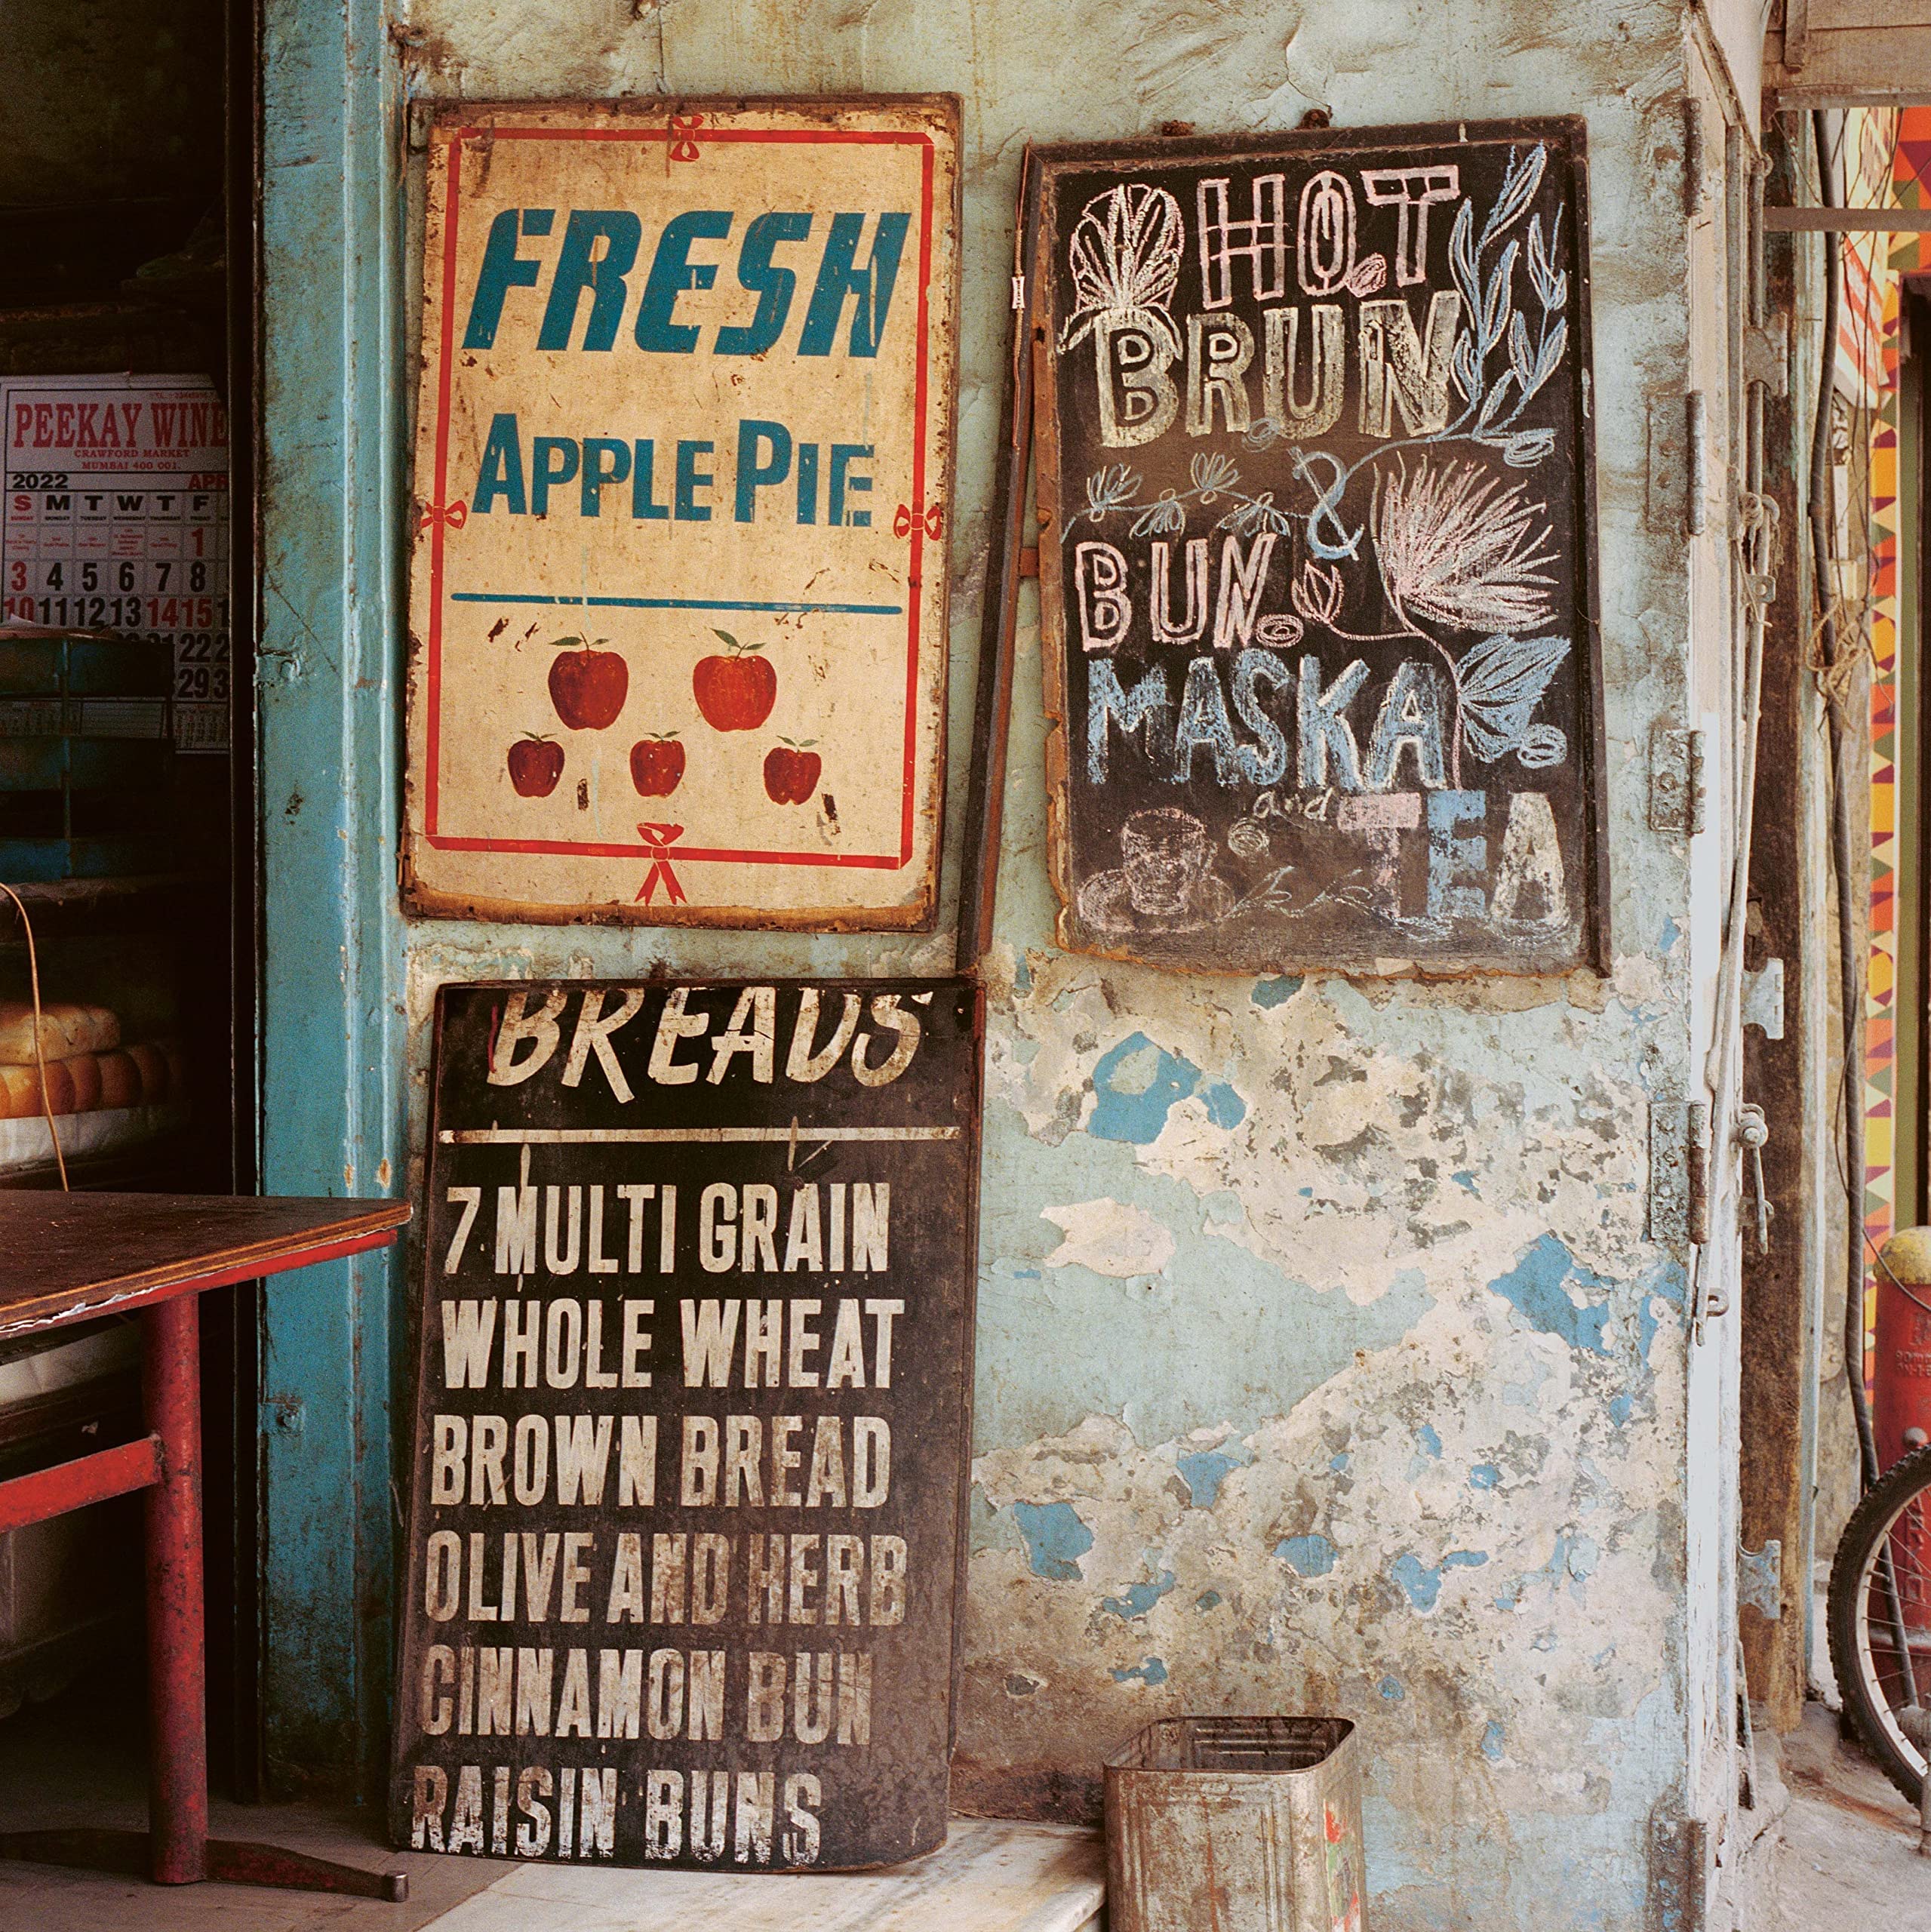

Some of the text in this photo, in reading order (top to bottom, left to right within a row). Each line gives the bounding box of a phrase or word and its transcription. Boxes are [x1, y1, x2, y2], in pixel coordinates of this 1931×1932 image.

[462, 208, 912, 358] FRESH
[1198, 165, 1461, 309] HOT
[1095, 289, 1462, 448] BRUN
[14, 403, 143, 448] PEEKAY
[74, 449, 190, 458] CRAWFORD MARKET
[82, 462, 129, 470] MUMBAI
[132, 462, 153, 470] 400
[471, 413, 875, 527] APPLE PIE
[12, 474, 68, 489] 2022
[14, 495, 210, 511] S M T W T F
[11, 561, 207, 592] 3 4 5 6 7 8
[191, 528, 204, 557] 1
[39, 597, 68, 626] 11
[75, 597, 106, 628] 12
[110, 597, 142, 627] 13
[147, 597, 179, 628] 14
[181, 597, 214, 628] 15
[1075, 532, 1277, 652] BUN
[177, 668, 210, 698] 29
[179, 632, 211, 663] 22
[1087, 648, 1447, 792] MASKA
[1336, 789, 1567, 926] TEA
[487, 986, 933, 1103] BREADS
[445, 1182, 890, 1275] 7 MULTI GRAIN
[441, 1298, 906, 1389] WHOLE WHEAT
[430, 1414, 891, 1508] BROWN BREAD
[424, 1530, 907, 1626] OLIVE AND HERB
[420, 1644, 872, 1746] CINNAMON BUN
[411, 1764, 823, 1866] RAISIN BUNS
